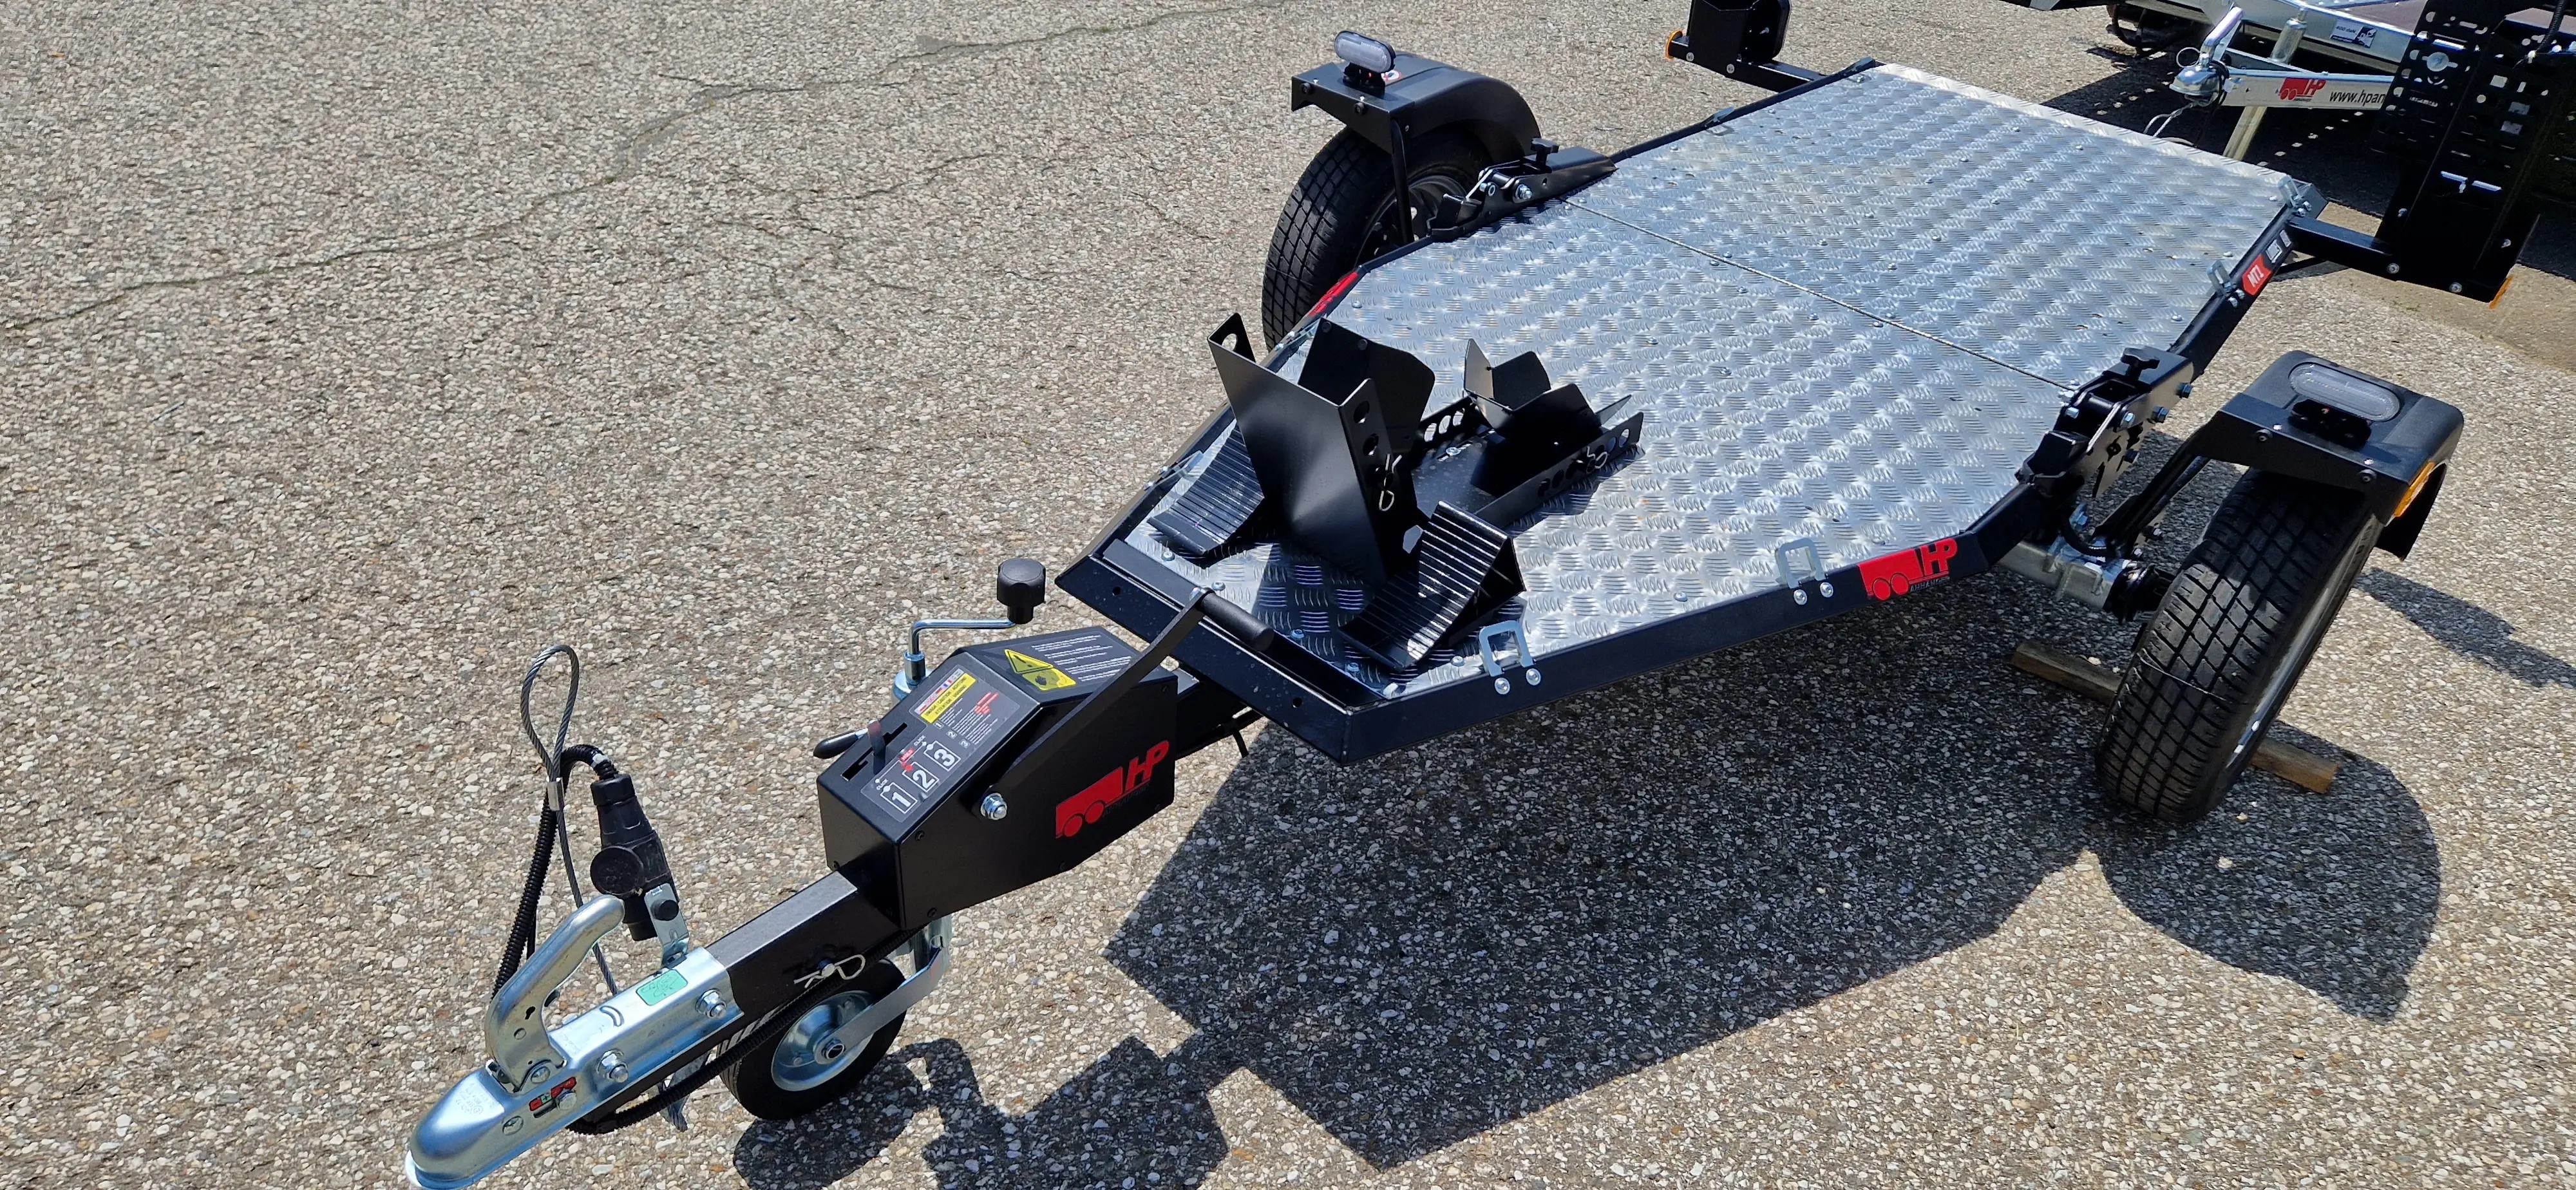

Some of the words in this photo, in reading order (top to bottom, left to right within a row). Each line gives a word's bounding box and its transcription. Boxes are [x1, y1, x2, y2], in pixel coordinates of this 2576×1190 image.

[2304, 79, 2326, 95] HP
[1919, 538, 1958, 576] HP
[913, 735, 926, 746] CLICK
[934, 748, 955, 766] 3
[1125, 740, 1170, 791] HP
[876, 779, 888, 791] CLICK
[913, 770, 935, 789] 2
[892, 791, 911, 808] 1
